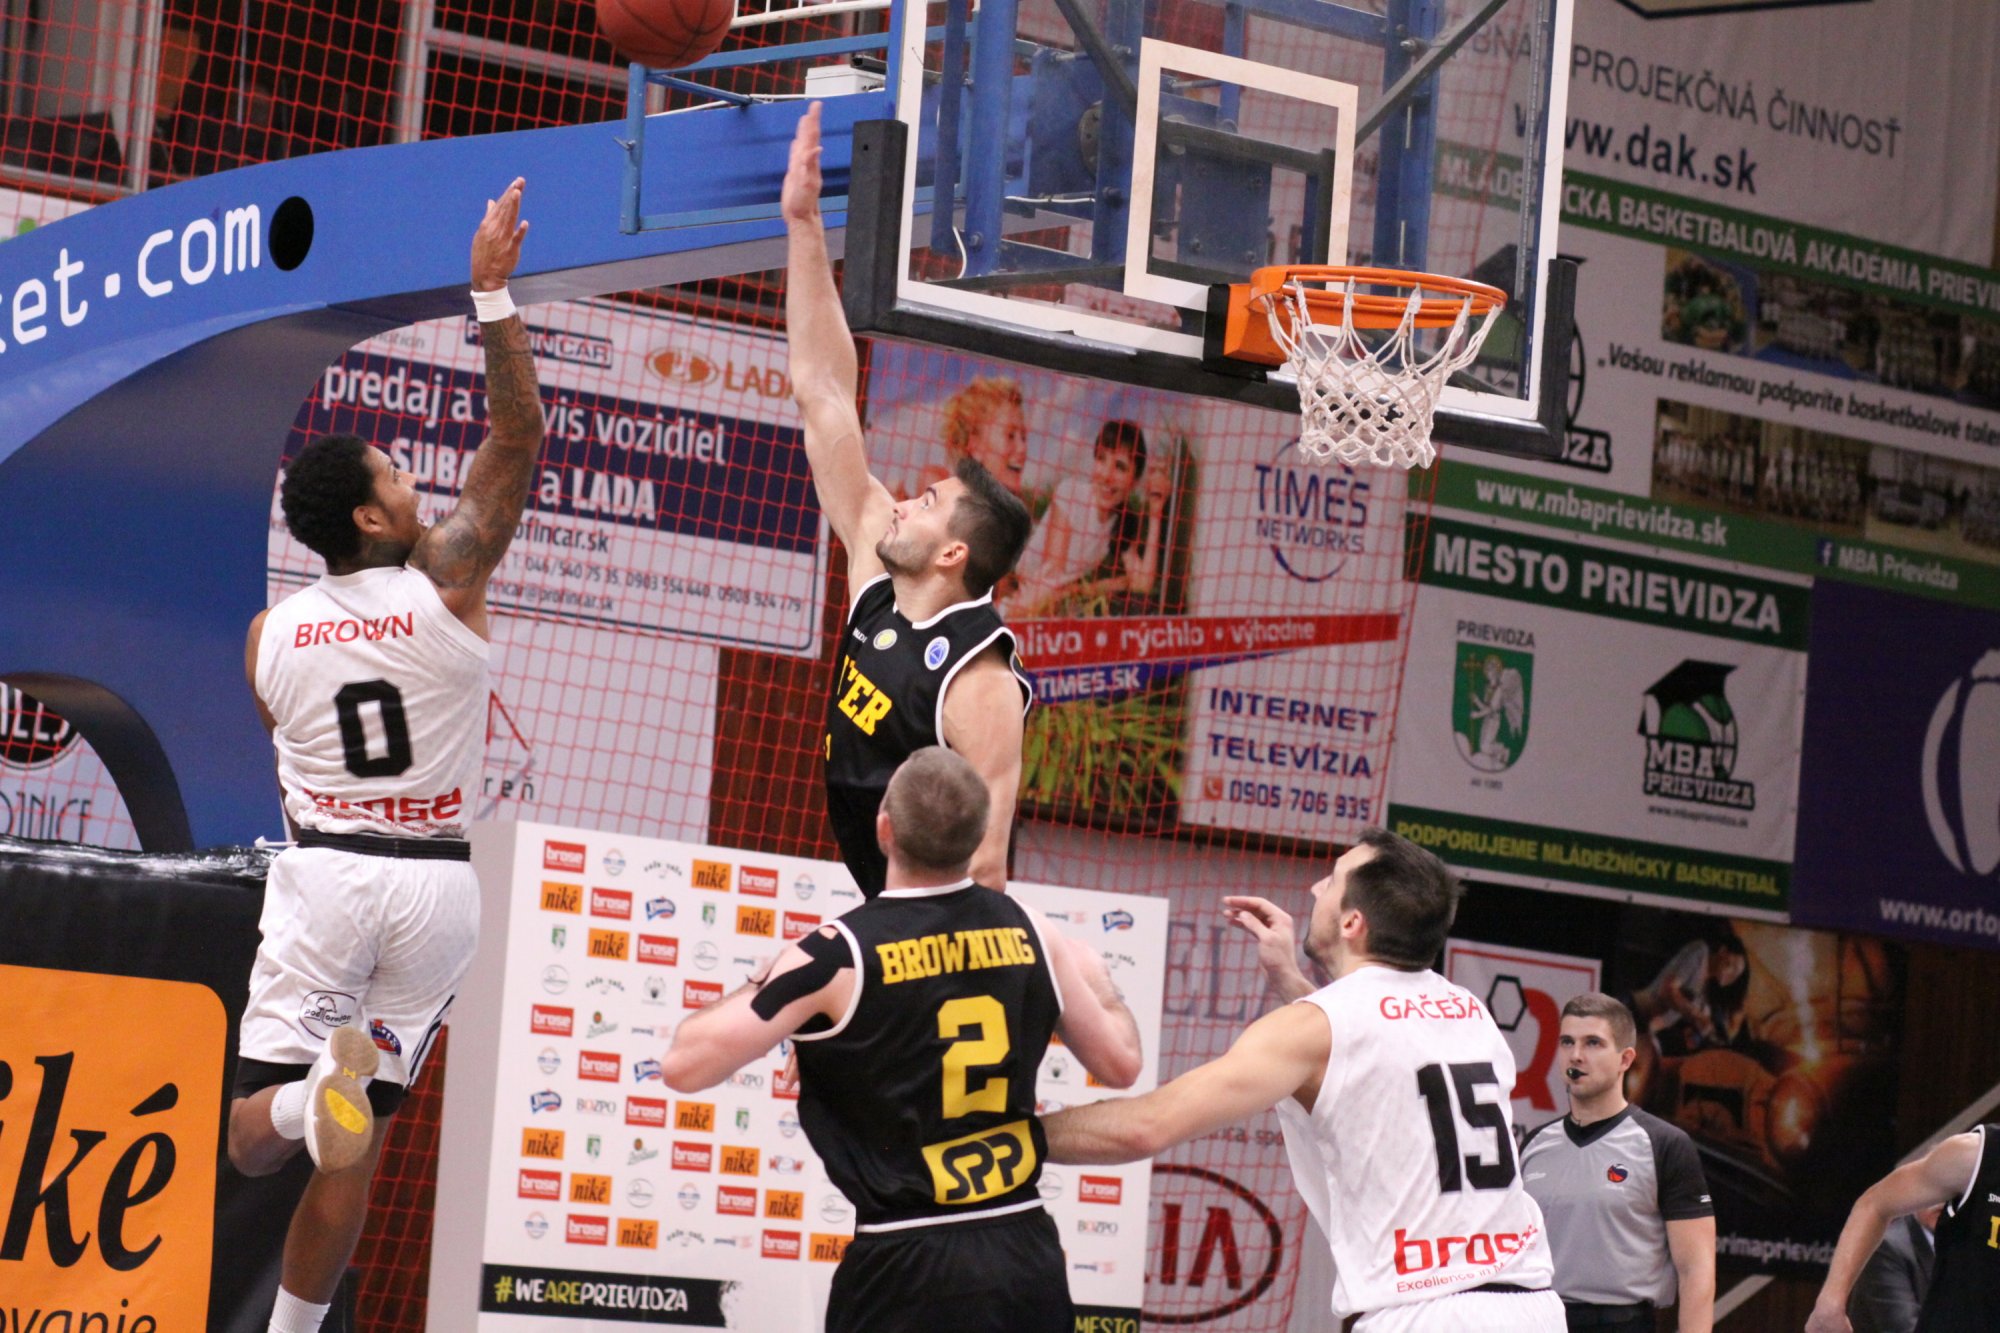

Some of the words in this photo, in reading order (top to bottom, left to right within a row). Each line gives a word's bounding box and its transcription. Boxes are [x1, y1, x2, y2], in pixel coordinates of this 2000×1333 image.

[1571, 44, 1758, 121] PROJEKČNÁ
[1768, 86, 1902, 159] ČINNOSŤ
[1619, 195, 1798, 266] BASKETBALOVÁ
[1804, 237, 1922, 294] AKADÉMIA
[0, 203, 261, 356] et.com
[1669, 357, 1755, 395] reklamou
[322, 365, 443, 428] predaj
[452, 386, 474, 412] a
[596, 412, 725, 466] vozidiel
[539, 469, 561, 508] a
[571, 466, 656, 521] LADA
[1255, 464, 1371, 528] TIMES
[1475, 476, 1728, 547] www.mbaprievidza.sk
[1256, 518, 1365, 555] NETWORKS
[1433, 532, 1569, 594] MESTO
[1580, 560, 1781, 634] PRIEVIDZA
[294, 612, 413, 648] BROWN
[1121, 617, 1205, 658] rýchlo
[1231, 619, 1315, 651] výhodne
[1456, 619, 1536, 649] PRIEVIDZA
[334, 677, 414, 779] 0
[1210, 687, 1377, 734] INTERNET
[1208, 732, 1372, 779] TELEVÍZIA
[1648, 737, 1717, 779] MBA
[1229, 780, 1282, 810] 0905
[1290, 787, 1329, 816] 706
[1335, 794, 1372, 823] 935
[1646, 771, 1752, 807] PRIEVIDZA
[696, 864, 727, 889] niké
[1396, 819, 1538, 861] PODPORUJEME
[1542, 841, 1672, 882] MLÁDEŽNÍCKY
[1676, 861, 1781, 896] BASKETBAL
[545, 886, 578, 911] niké
[1880, 897, 2000, 938] www.orto
[741, 911, 771, 934] niké
[592, 932, 625, 958] niké
[876, 927, 1036, 985] BROWNING
[1380, 991, 1483, 1020] GAČEŠA
[937, 995, 1010, 1119] 2
[679, 1105, 711, 1130] niké
[1416, 1061, 1517, 1194] 15
[0, 1051, 180, 1272] ké
[526, 1132, 559, 1157] niké
[724, 1150, 756, 1175] niké
[941, 1131, 1024, 1202] SPP
[574, 1177, 607, 1203] niké
[769, 1194, 800, 1217] niké
[621, 1221, 654, 1247] niké
[1077, 1219, 1119, 1235] BOZPO
[494, 1276, 689, 1312] #WEAREPRIEVIDZA
[1396, 1271, 1475, 1294] Excellence
[0, 1298, 158, 1333] vanie
